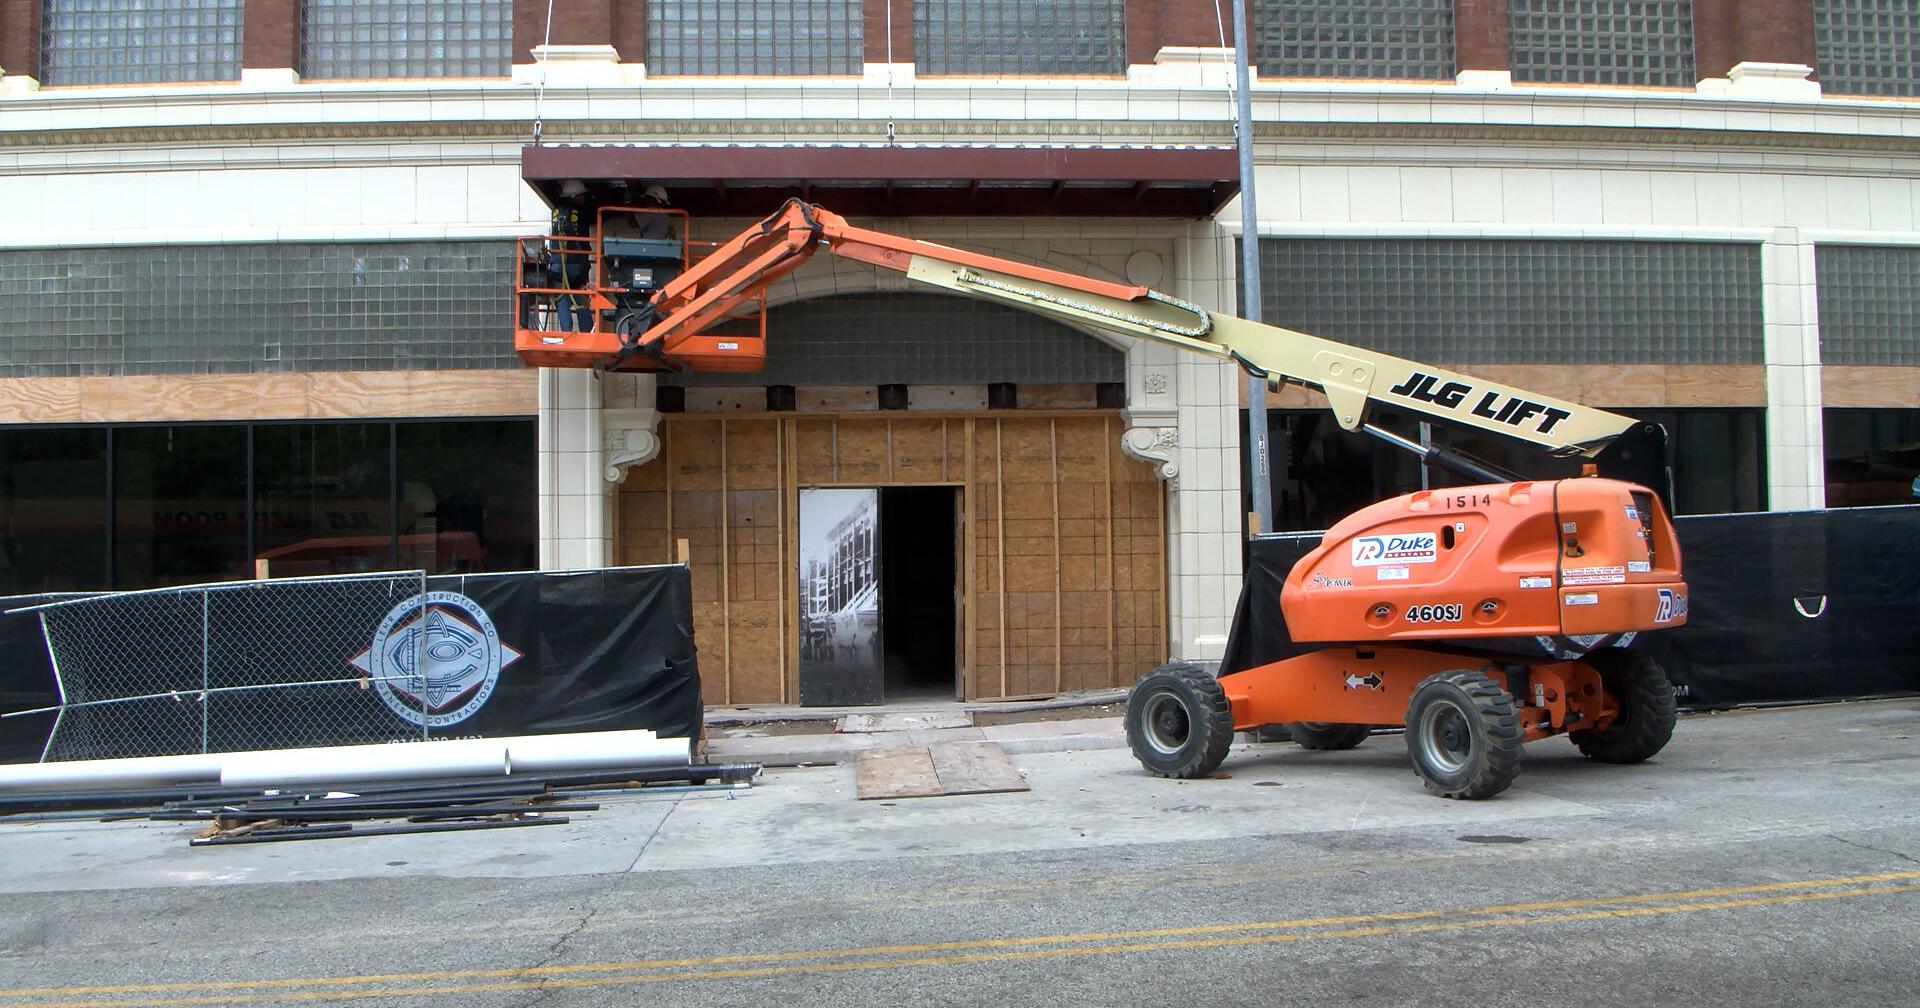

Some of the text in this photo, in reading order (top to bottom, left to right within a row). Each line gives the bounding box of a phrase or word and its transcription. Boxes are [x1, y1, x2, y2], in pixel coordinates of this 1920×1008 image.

[1388, 371, 1572, 435] JLG LIFT
[1446, 494, 1491, 509] 1514
[400, 592, 483, 618] CONSTRUCTION
[1405, 603, 1463, 622] 460SJ
[379, 679, 495, 724] GENERAL CONTRACTORS
